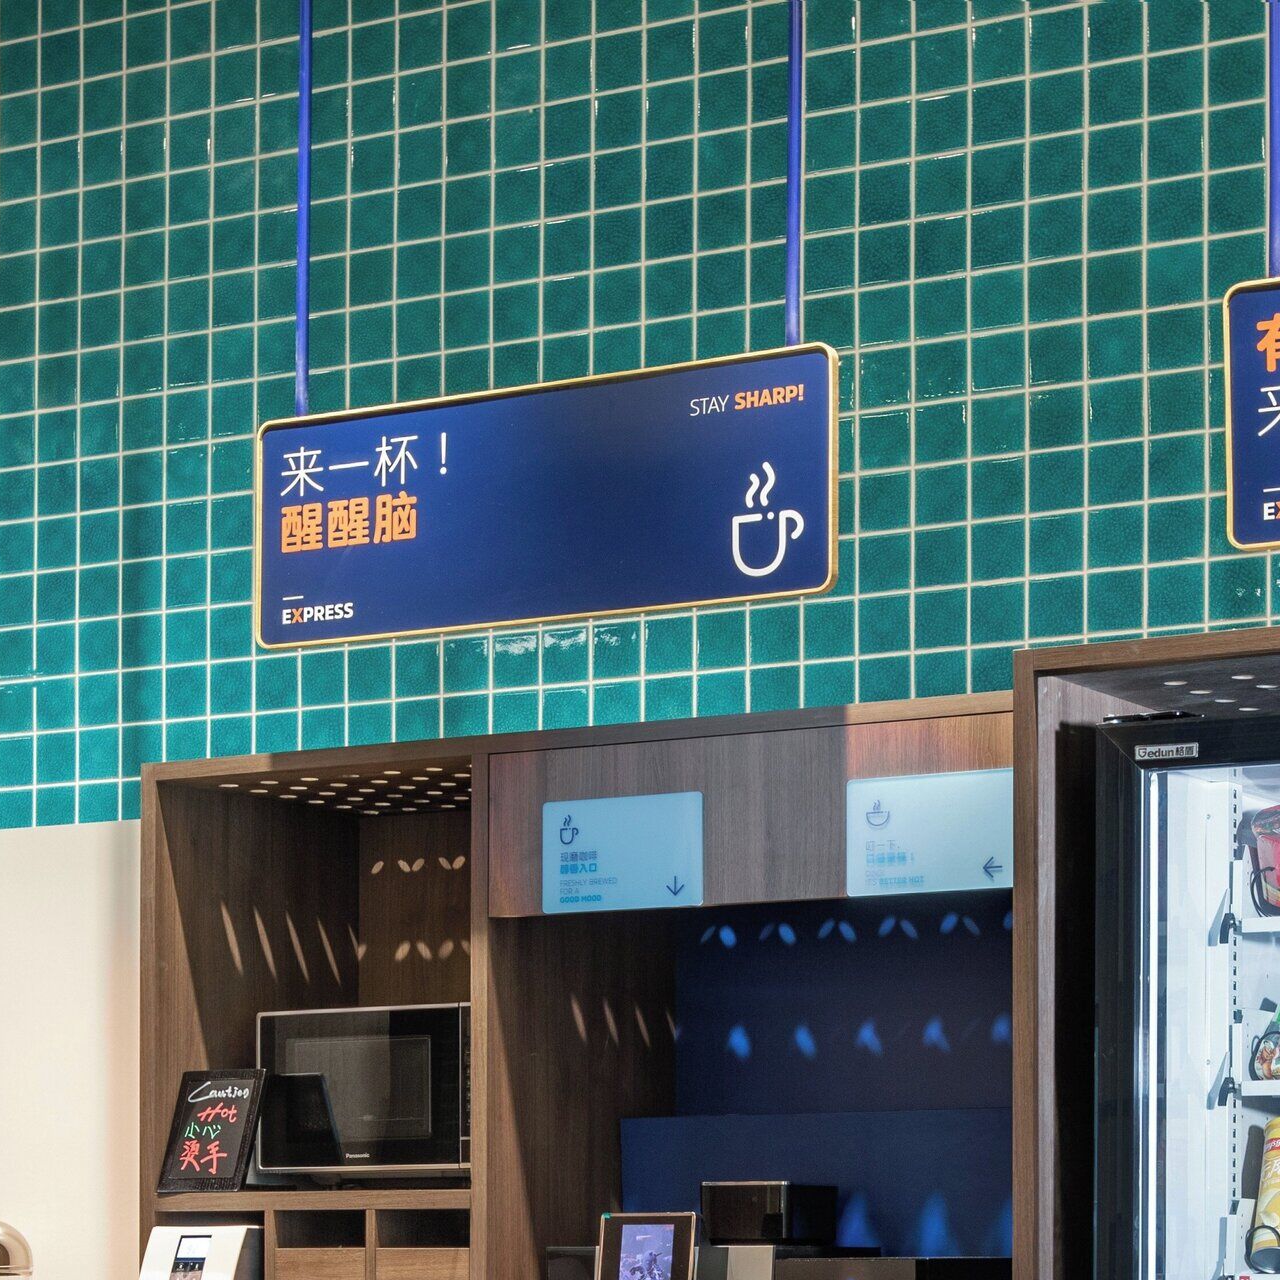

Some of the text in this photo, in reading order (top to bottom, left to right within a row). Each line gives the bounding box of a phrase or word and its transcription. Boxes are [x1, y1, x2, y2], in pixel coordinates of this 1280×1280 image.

[690, 384, 804, 417] STAY SHARP!
[281, 490, 418, 554] 醒醒脑
[282, 602, 354, 625] EXPRESS
[187, 1081, 250, 1103] Caution
[197, 1101, 237, 1123] Hot
[184, 1121, 222, 1139] 小心
[180, 1140, 227, 1174] 烫手
